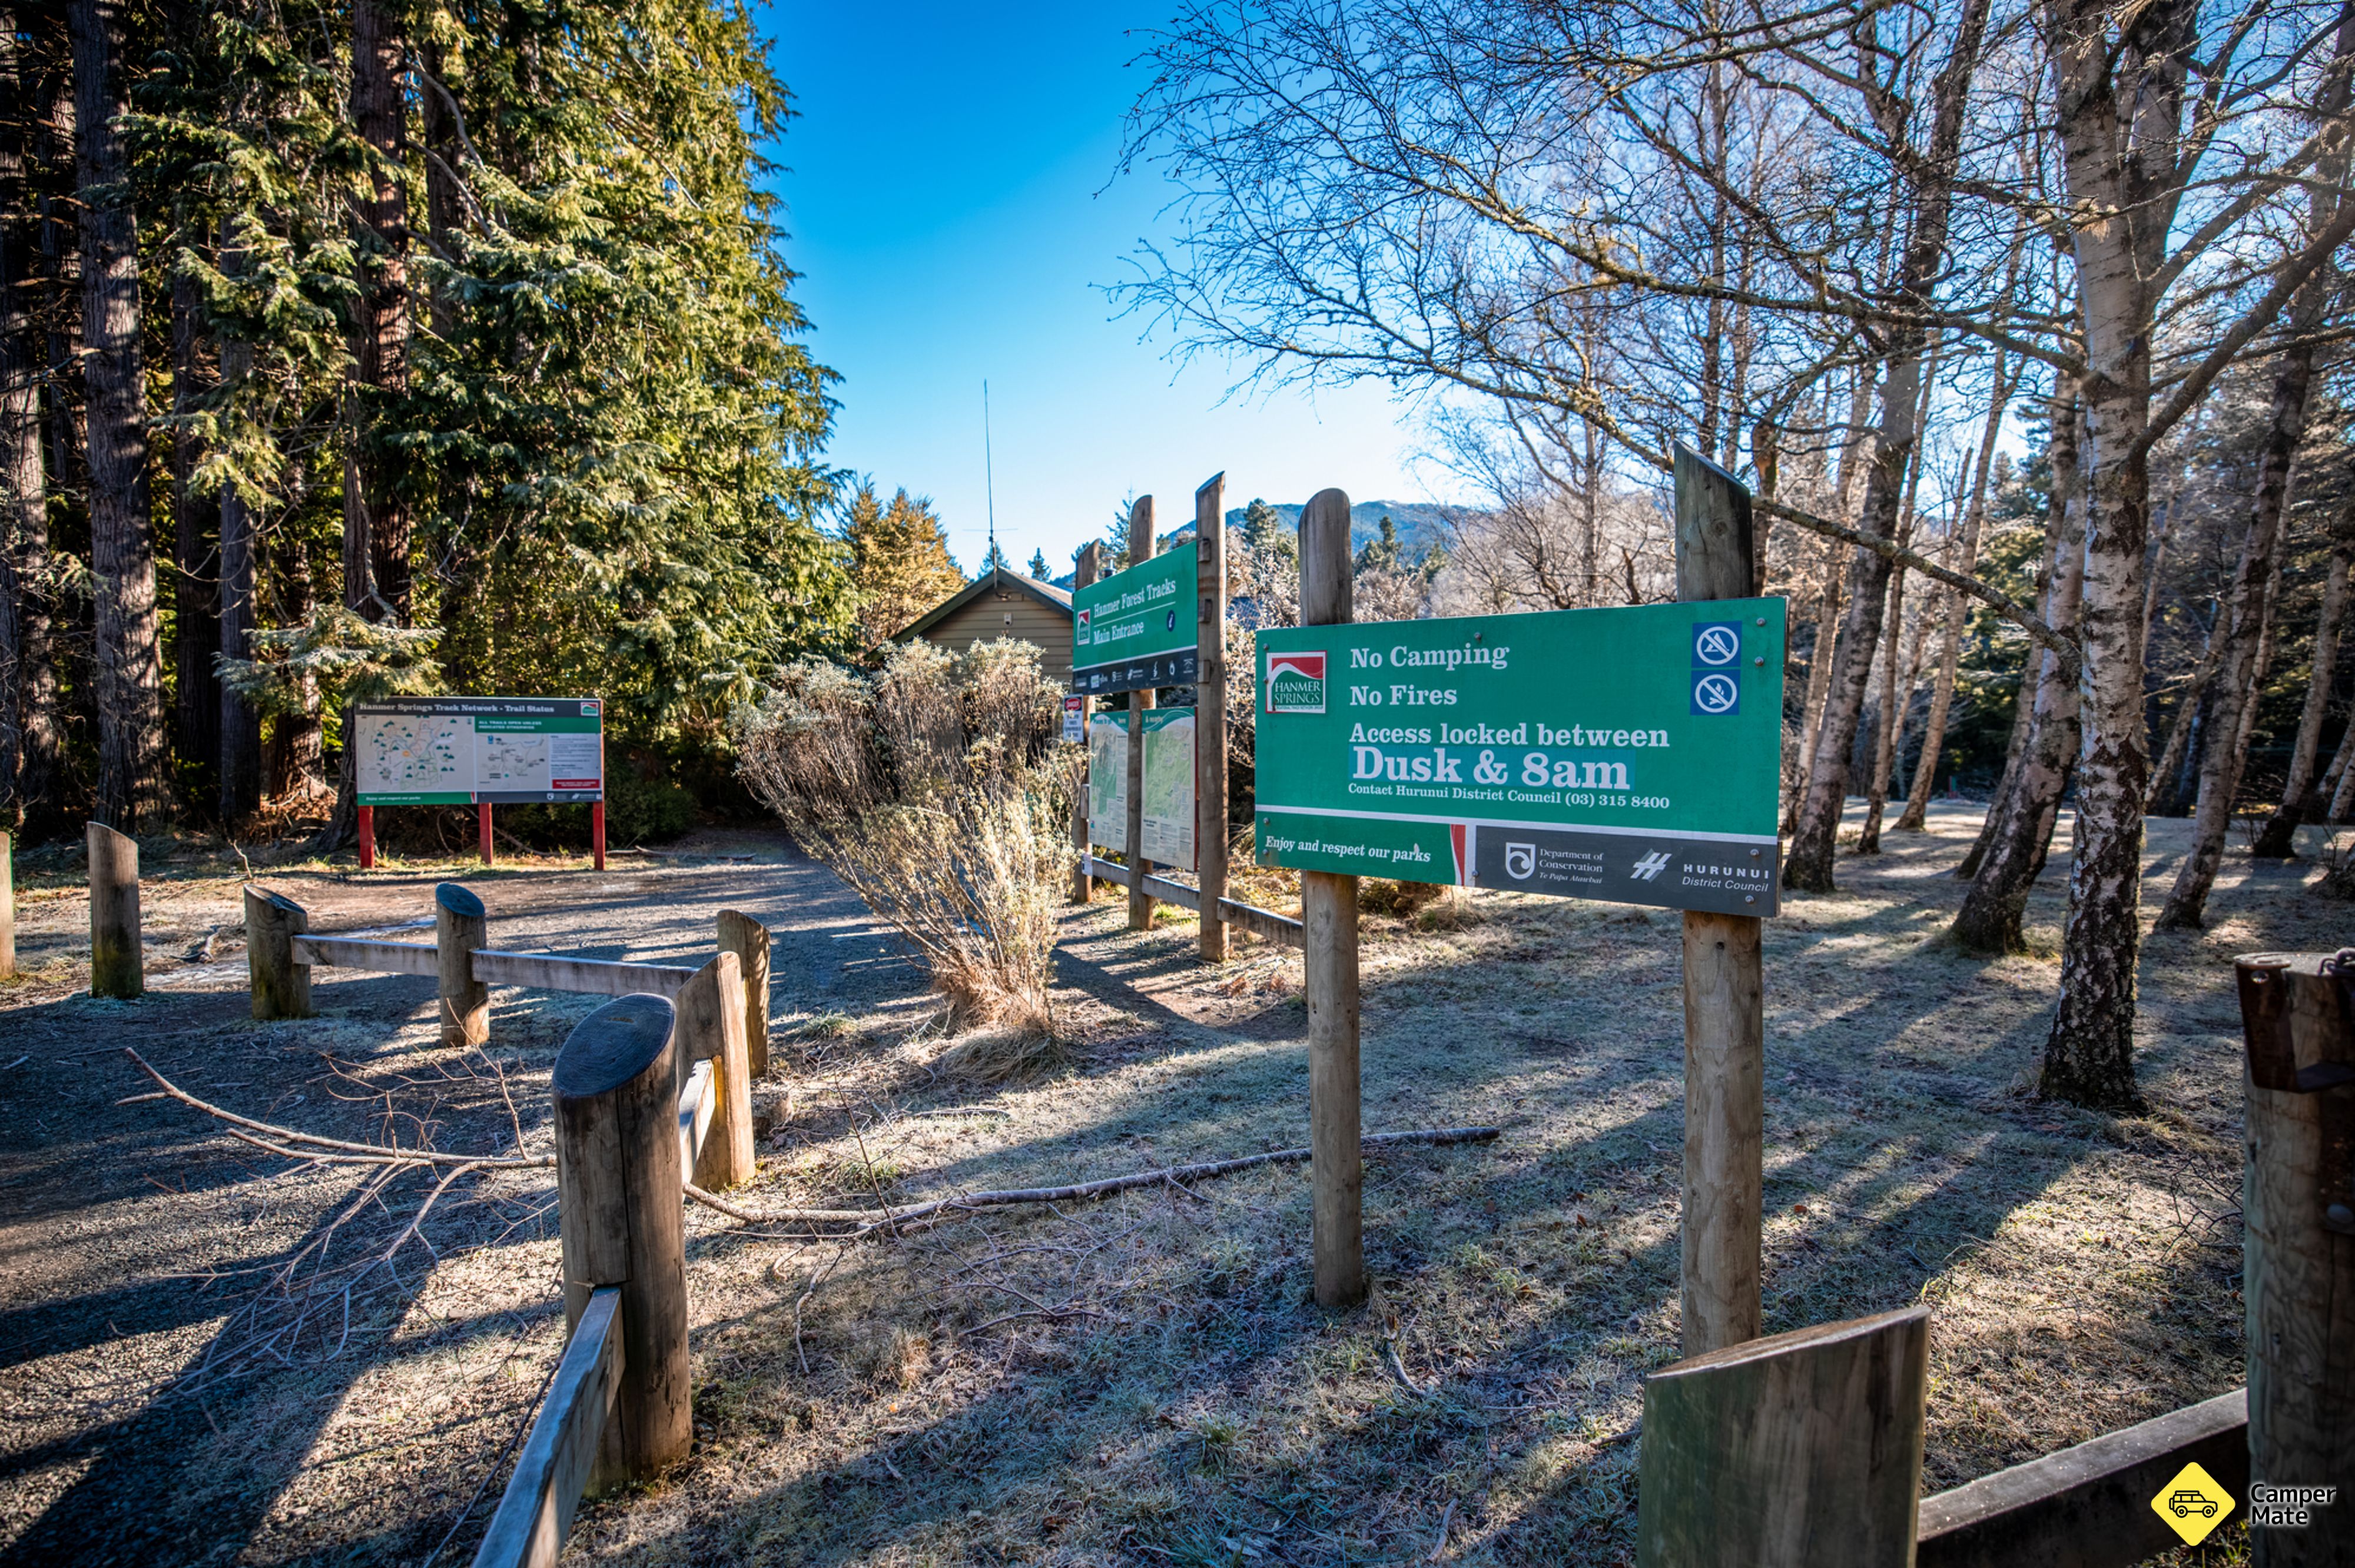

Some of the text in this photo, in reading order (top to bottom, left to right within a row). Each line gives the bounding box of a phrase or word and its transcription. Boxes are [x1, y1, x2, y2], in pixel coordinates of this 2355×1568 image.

[1094, 578, 1176, 618] Hanmer Forest Tracks
[1093, 628, 1110, 645] Main
[1112, 622, 1144, 640] Entrance
[1350, 643, 1510, 671] No Camping
[1275, 681, 1321, 692] HANMER
[1350, 685, 1457, 706] No Fires
[1275, 692, 1320, 703] SPRINGS
[397, 703, 433, 712] Springs
[527, 705, 555, 713] Status
[1349, 723, 1670, 747] Access locked between
[1353, 746, 1630, 790] Dusk & 8am
[1348, 783, 1670, 809] Contact Hurunui District Council (03) 315 8400
[1265, 836, 1431, 862] Enjoy and respect our parks
[1540, 849, 1591, 860] Department
[1539, 859, 1603, 872] Conservation
[1683, 863, 1769, 879] HURUNUI
[1549, 873, 1568, 882] Papa
[1570, 875, 1603, 884] Atawhai
[1682, 876, 1769, 892] District Council
